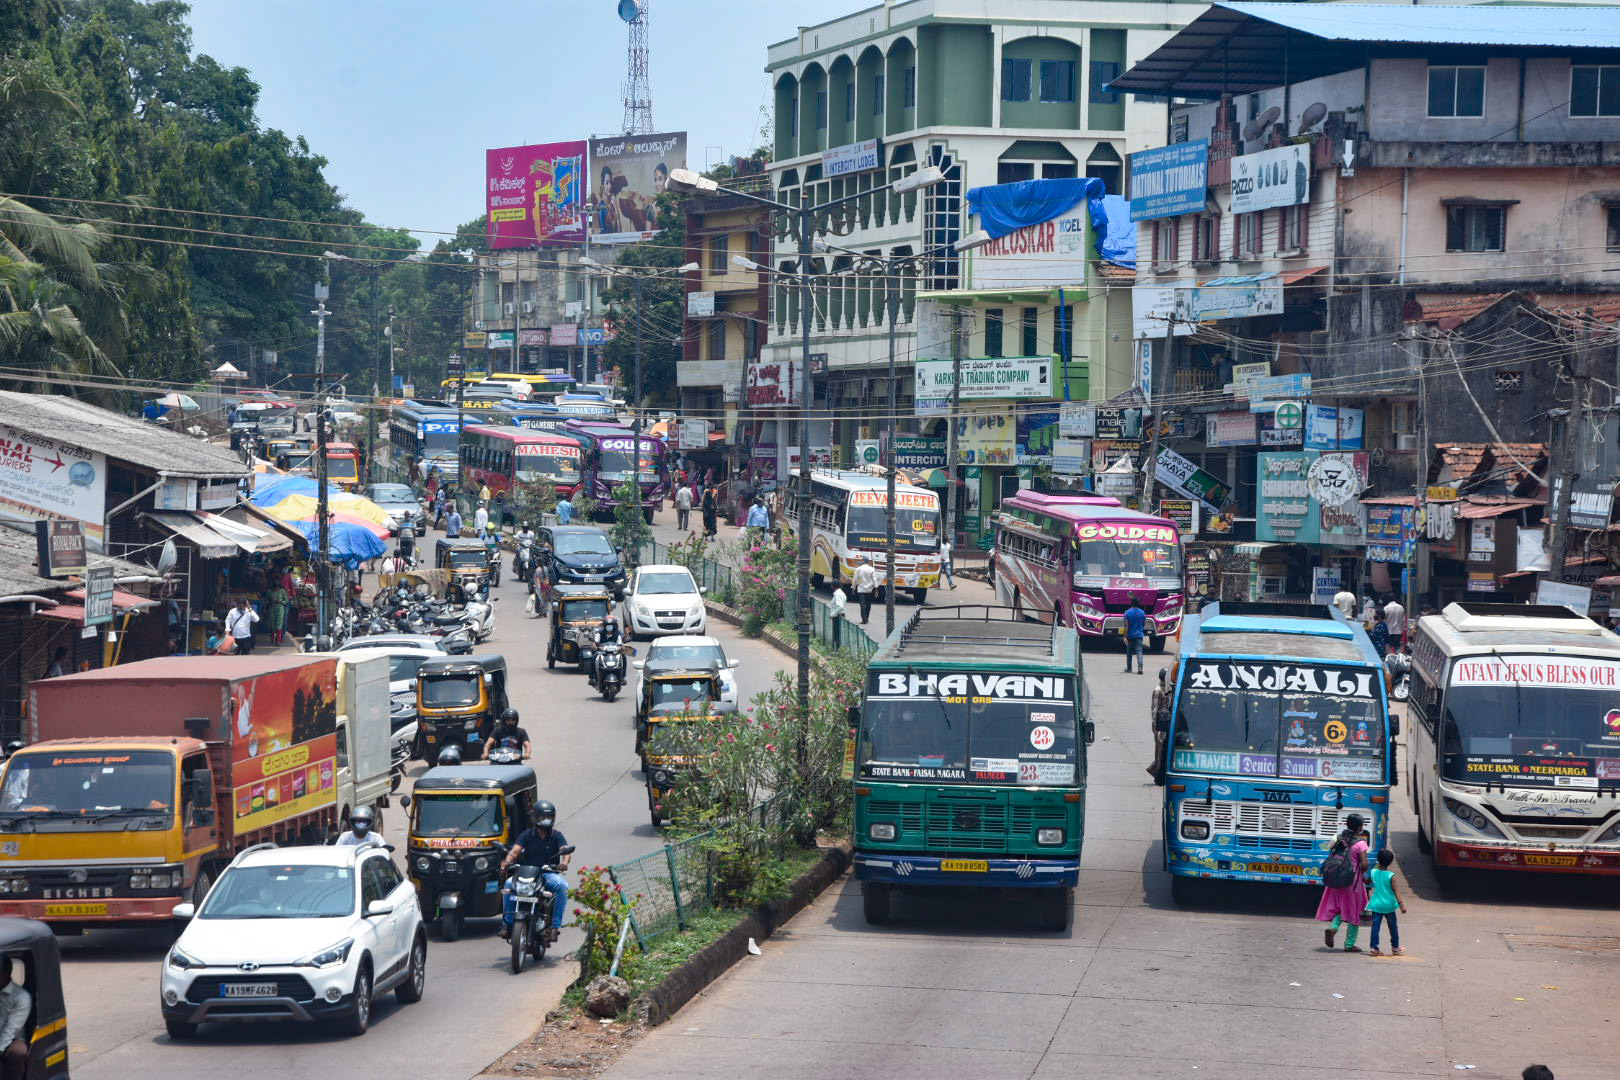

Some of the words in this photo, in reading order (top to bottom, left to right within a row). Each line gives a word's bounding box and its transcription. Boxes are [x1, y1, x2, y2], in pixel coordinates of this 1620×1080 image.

[857, 153, 875, 169] LODGE
[1132, 169, 1164, 200] NATIONAL
[1165, 161, 1204, 194] TUTORIALS
[934, 370, 964, 385] KARKEA
[966, 369, 995, 385] TRADING
[996, 368, 1031, 384] COMPANY
[516, 445, 579, 457] MAHESH
[894, 455, 945, 465] INTERCITY
[1156, 456, 1186, 482] OKAYA
[1078, 525, 1175, 541] GOLDEN
[1190, 663, 1374, 698] ANJALI
[1459, 662, 1502, 682] INFANT
[1505, 663, 1544, 683] JESUS
[1546, 664, 1587, 685] BLESS
[1590, 665, 1616, 686] OUR
[878, 673, 1065, 699] BHAVANI
[871, 767, 892, 777] STATE
[892, 768, 911, 778] BANK
[936, 768, 966, 780] NAGARA
[1467, 763, 1494, 773] STATE
[1495, 764, 1520, 774] BANK
[1529, 765, 1588, 777] NEERMARGA
[1262, 792, 1292, 802] TATA
[1560, 792, 1597, 805] Travels
[43, 887, 114, 899] EICHER
